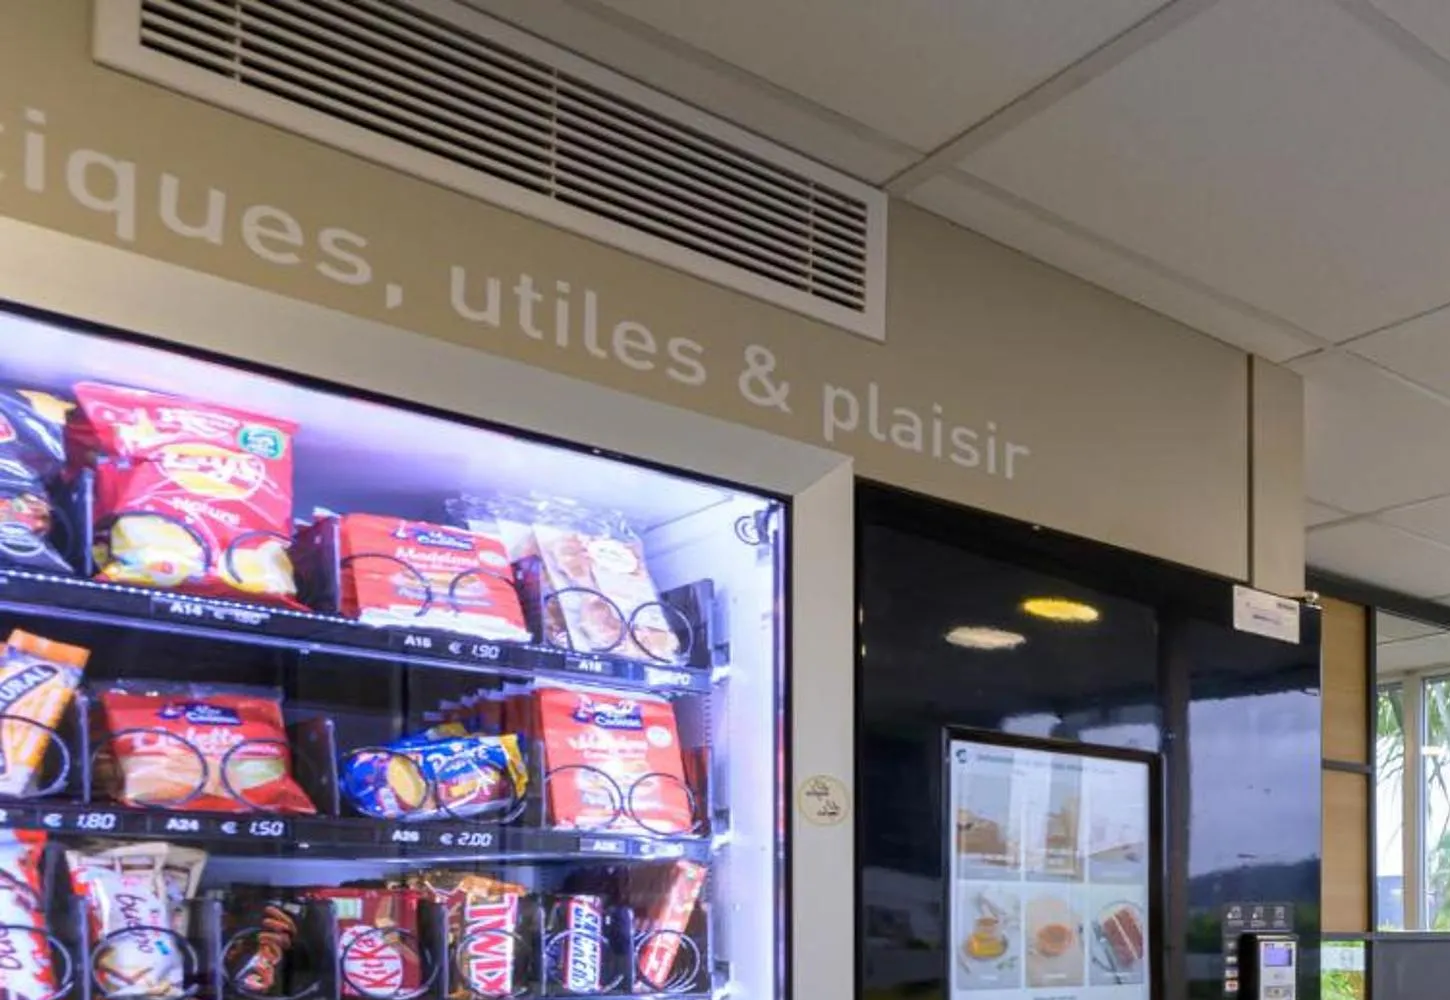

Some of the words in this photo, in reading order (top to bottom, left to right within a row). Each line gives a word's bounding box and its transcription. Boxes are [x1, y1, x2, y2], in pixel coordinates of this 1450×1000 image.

[0, 108, 403, 310] iques,
[449, 264, 707, 386] utiles
[738, 344, 792, 413] &
[822, 381, 1030, 480] plaisir
[76, 812, 117, 830] 1.80
[249, 820, 285, 837] 1.50
[457, 831, 493, 847] 2.00
